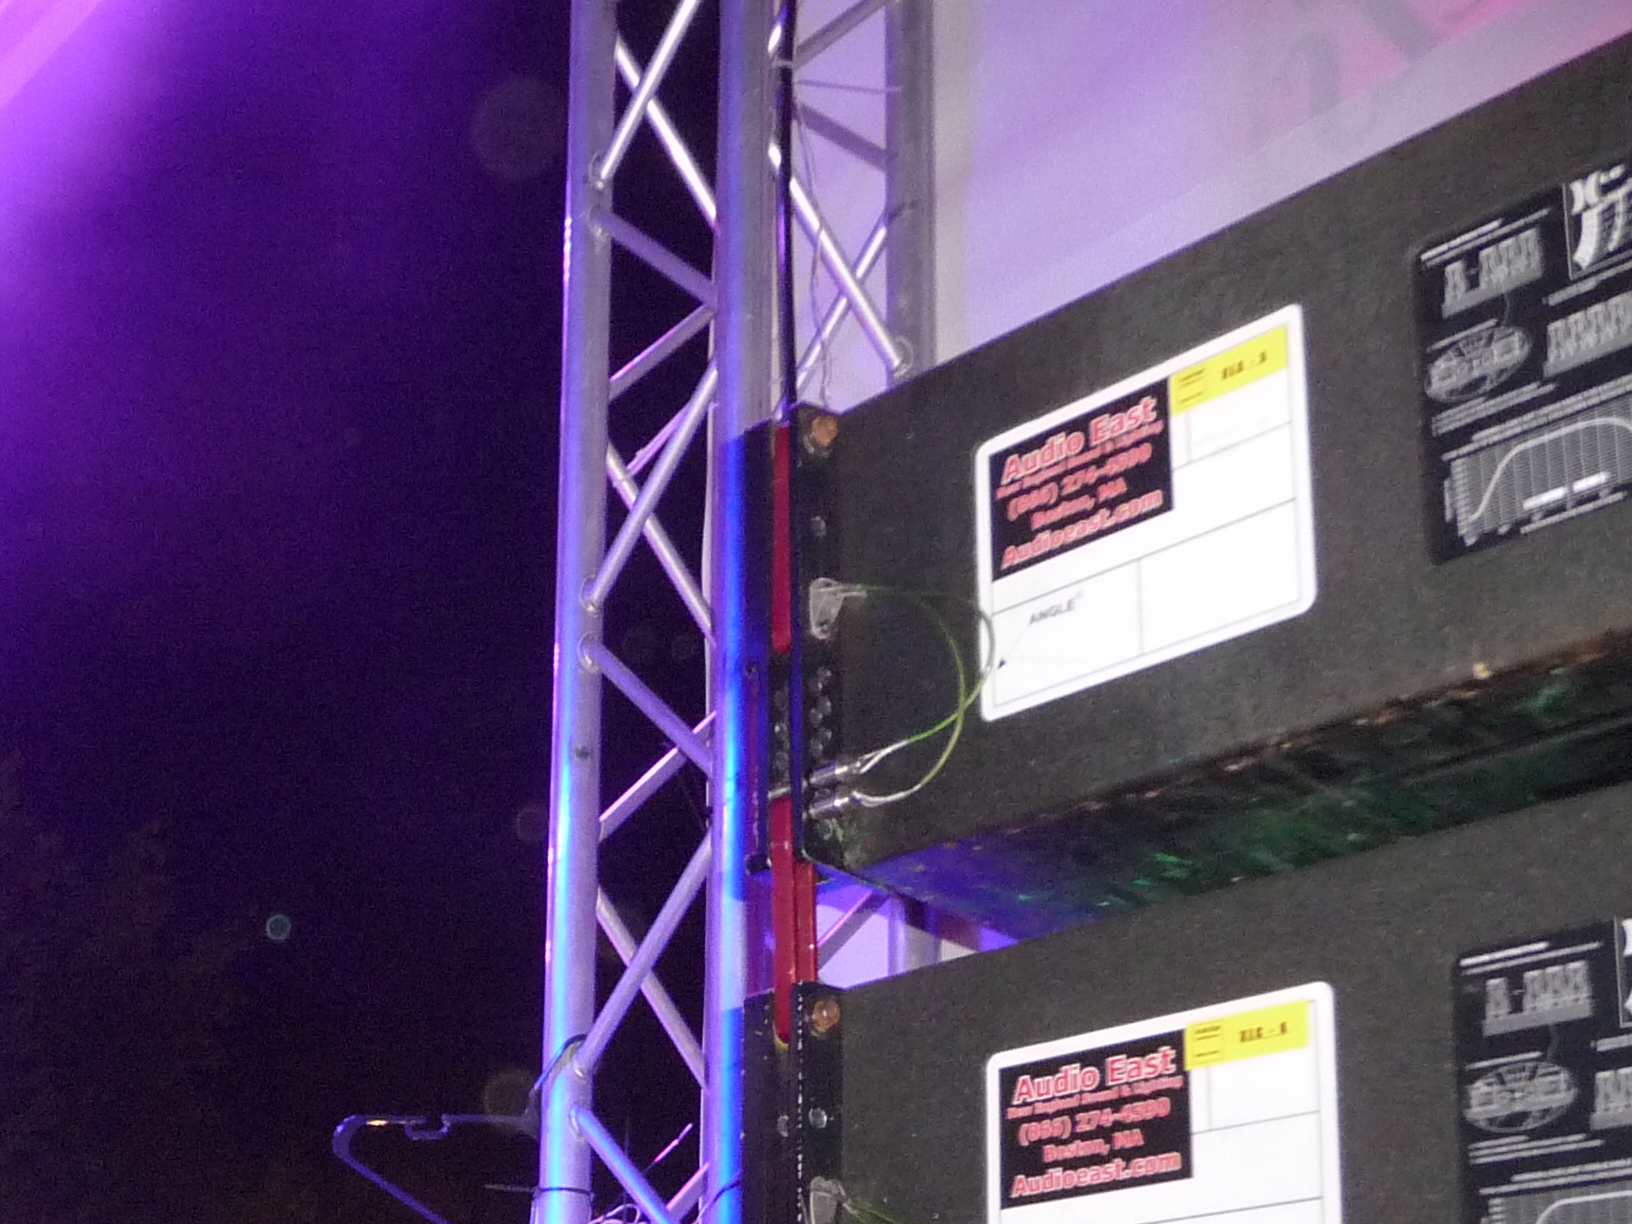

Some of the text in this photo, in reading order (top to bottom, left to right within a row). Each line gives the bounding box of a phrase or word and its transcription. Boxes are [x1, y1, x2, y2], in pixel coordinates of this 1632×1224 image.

[1000, 431, 1085, 485] Audio
[1089, 395, 1157, 447] East
[1012, 1046, 1176, 1105] Audio East
[1010, 1151, 1183, 1198] Audioeast.com
